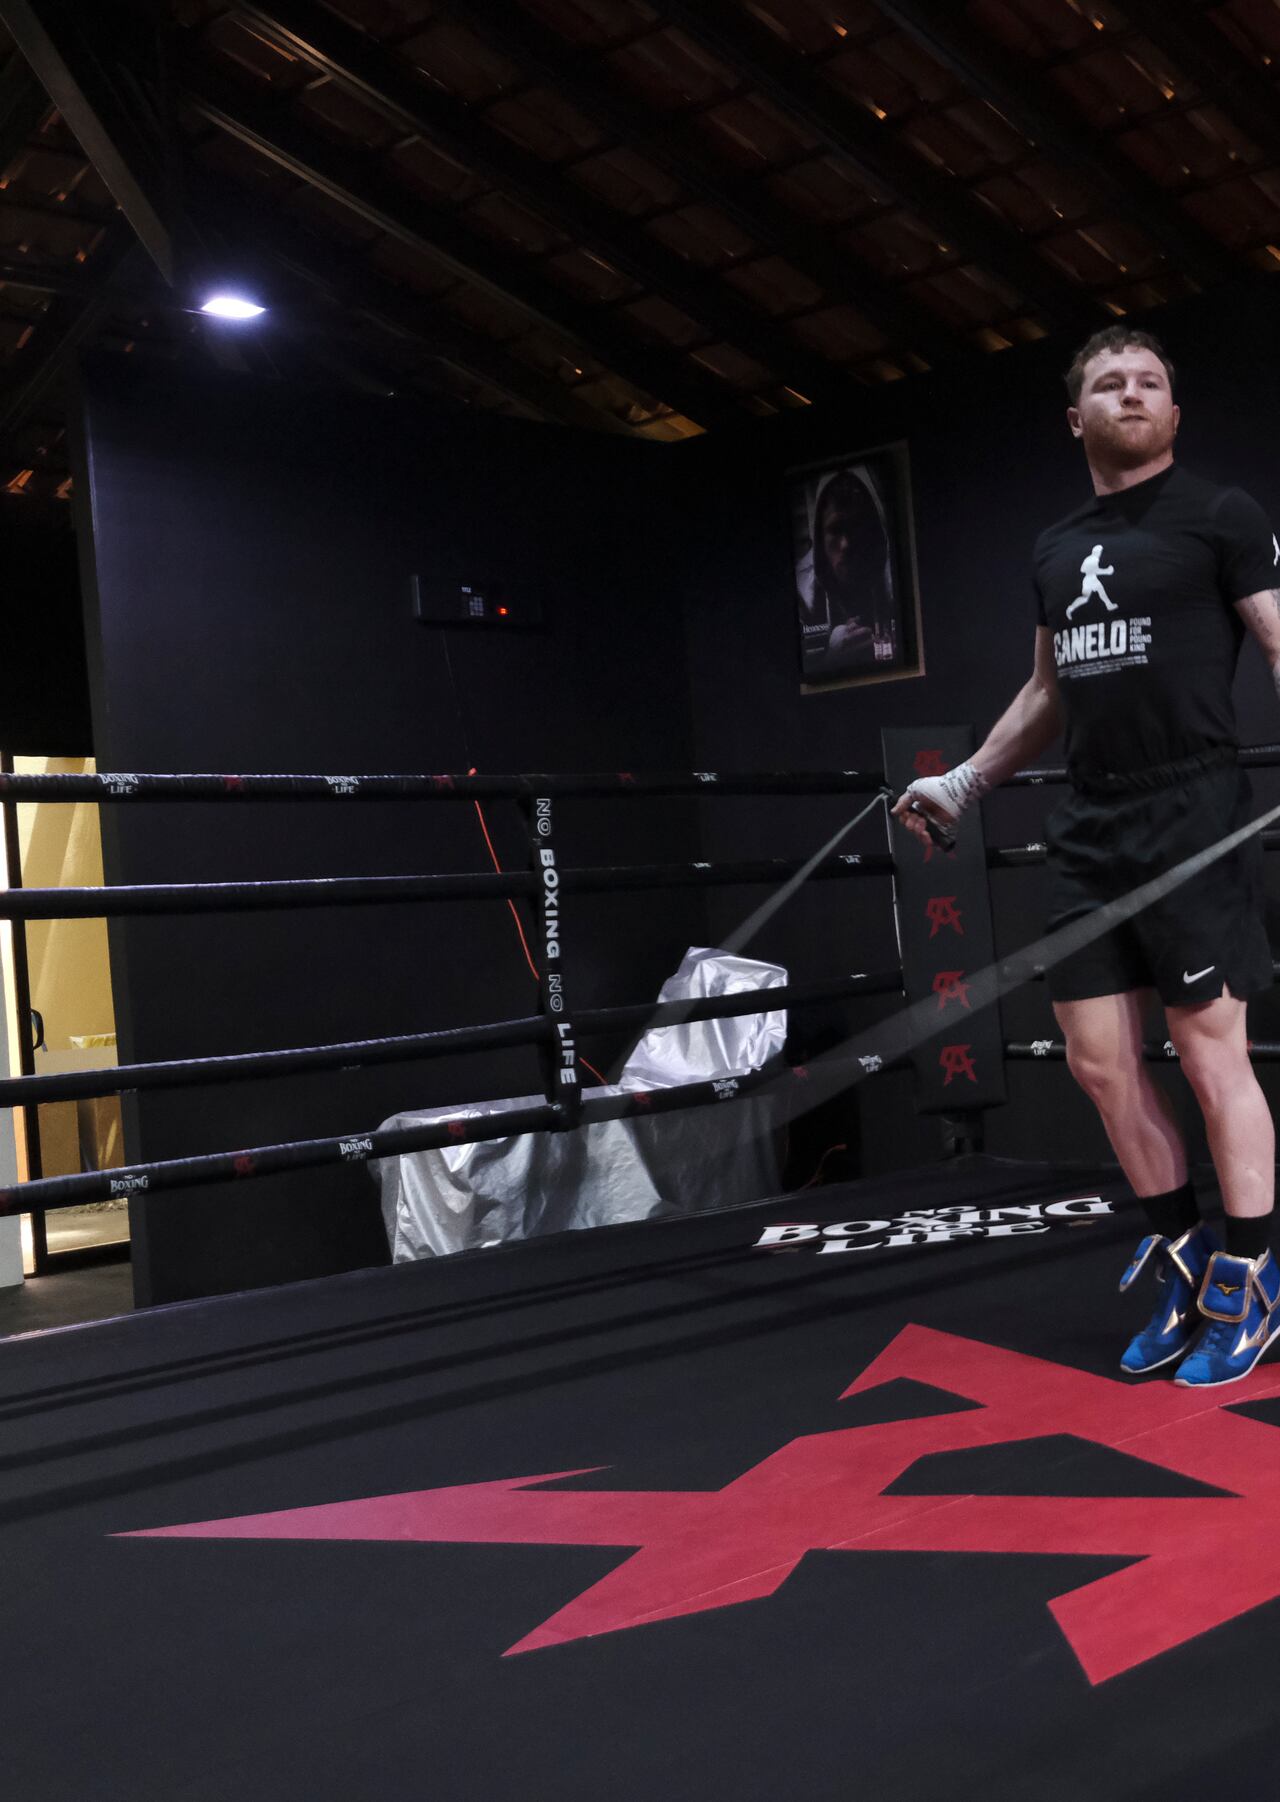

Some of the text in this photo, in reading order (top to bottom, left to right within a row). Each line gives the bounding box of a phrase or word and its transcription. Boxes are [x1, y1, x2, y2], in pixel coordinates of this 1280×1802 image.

[1053, 619, 1127, 666] CANELO
[110, 785, 134, 794] LIFE
[335, 785, 356, 794] LIFE
[536, 798, 577, 1085] NO BOXING NO LIFE
[339, 1138, 373, 1155] BOXING
[110, 1174, 149, 1193] BOXING
[752, 1195, 1115, 1247] BOXING
[902, 1205, 977, 1218] NO
[816, 1220, 1051, 1255] LIFE
